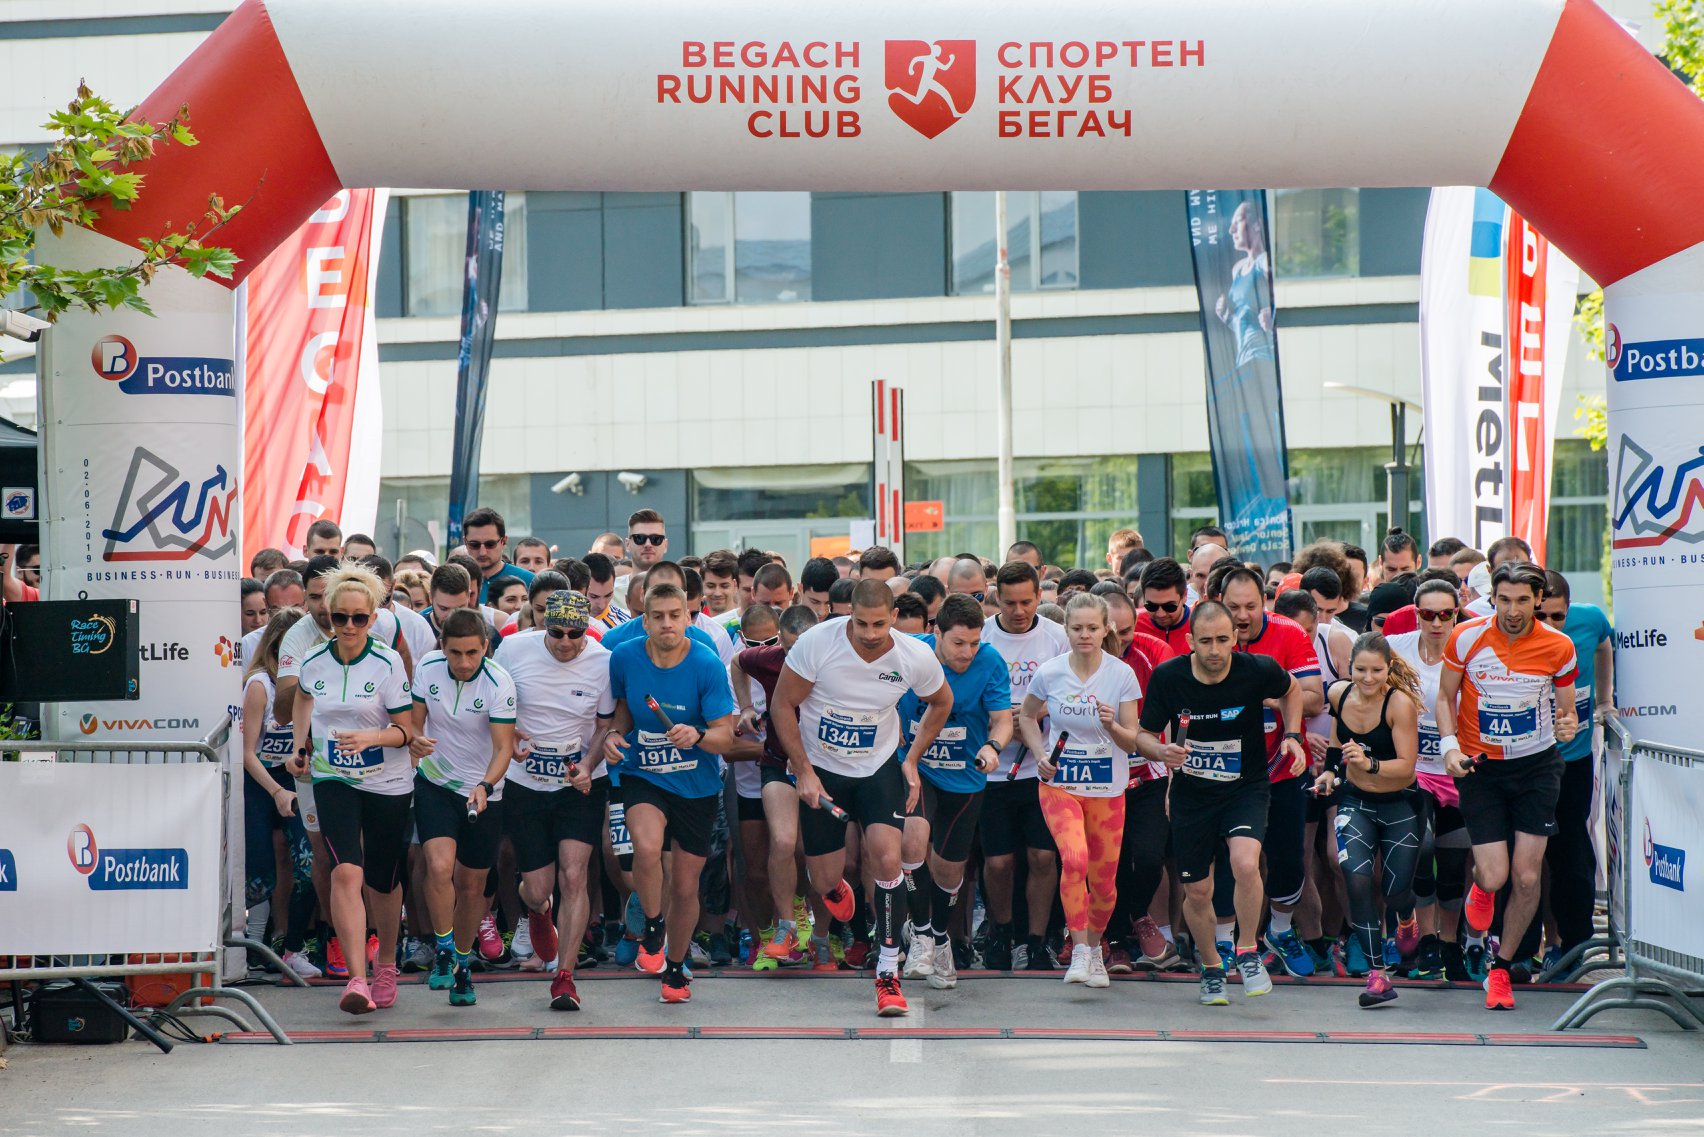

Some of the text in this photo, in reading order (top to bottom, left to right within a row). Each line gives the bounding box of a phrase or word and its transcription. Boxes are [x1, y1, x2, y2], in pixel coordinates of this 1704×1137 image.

[682, 41, 861, 69] BEGACH
[997, 40, 1206, 69] СПОРТЕН
[657, 75, 862, 104] RUNNING
[998, 74, 1113, 104] КЛУБ
[747, 110, 862, 138] CLUB
[998, 109, 1133, 138] БЕГАЧ
[71, 619, 99, 630] Race
[71, 631, 106, 643] Timing
[1617, 629, 1668, 650] MetLife
[1009, 674, 1033, 686] urt
[1221, 710, 1240, 719] SAP
[102, 718, 199, 731] VIVACOM
[1489, 718, 1513, 735] 4A
[820, 724, 860, 746] 134A
[263, 738, 294, 752] 257
[333, 749, 365, 766] 33A
[638, 748, 683, 765] 191A
[1184, 754, 1226, 770] 201A
[526, 759, 567, 776] 216A
[1060, 764, 1093, 781] 11A
[609, 825, 631, 843] 57
[104, 856, 180, 882] Postbank
[1653, 857, 1681, 884] Postbank
